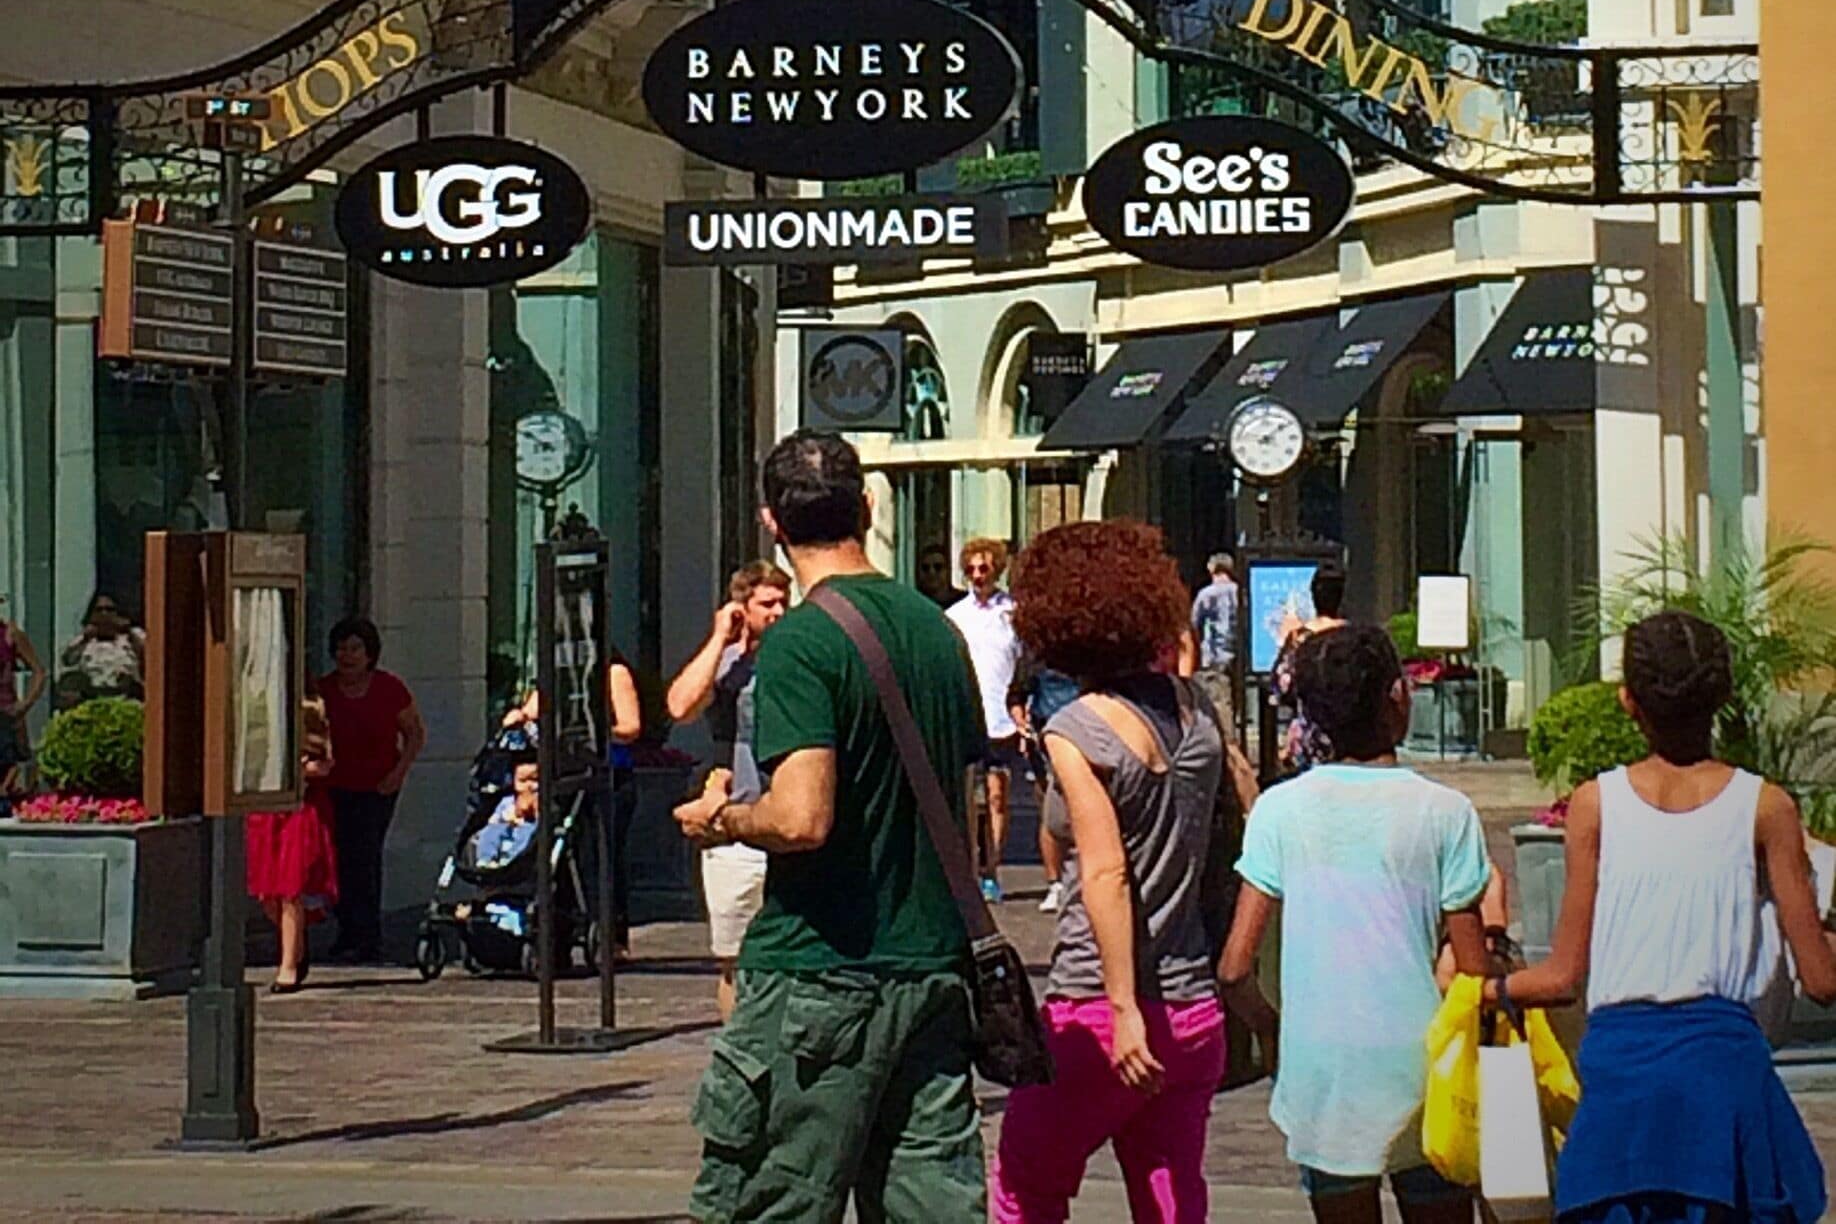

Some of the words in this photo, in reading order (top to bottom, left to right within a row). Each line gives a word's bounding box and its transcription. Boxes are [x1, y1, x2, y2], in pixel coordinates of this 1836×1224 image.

[688, 42, 966, 78] BARNEYS
[1143, 141, 1290, 195] See's
[378, 163, 543, 244] UGG
[1124, 196, 1311, 237] CANDIES
[688, 206, 976, 251] UNIONMADE
